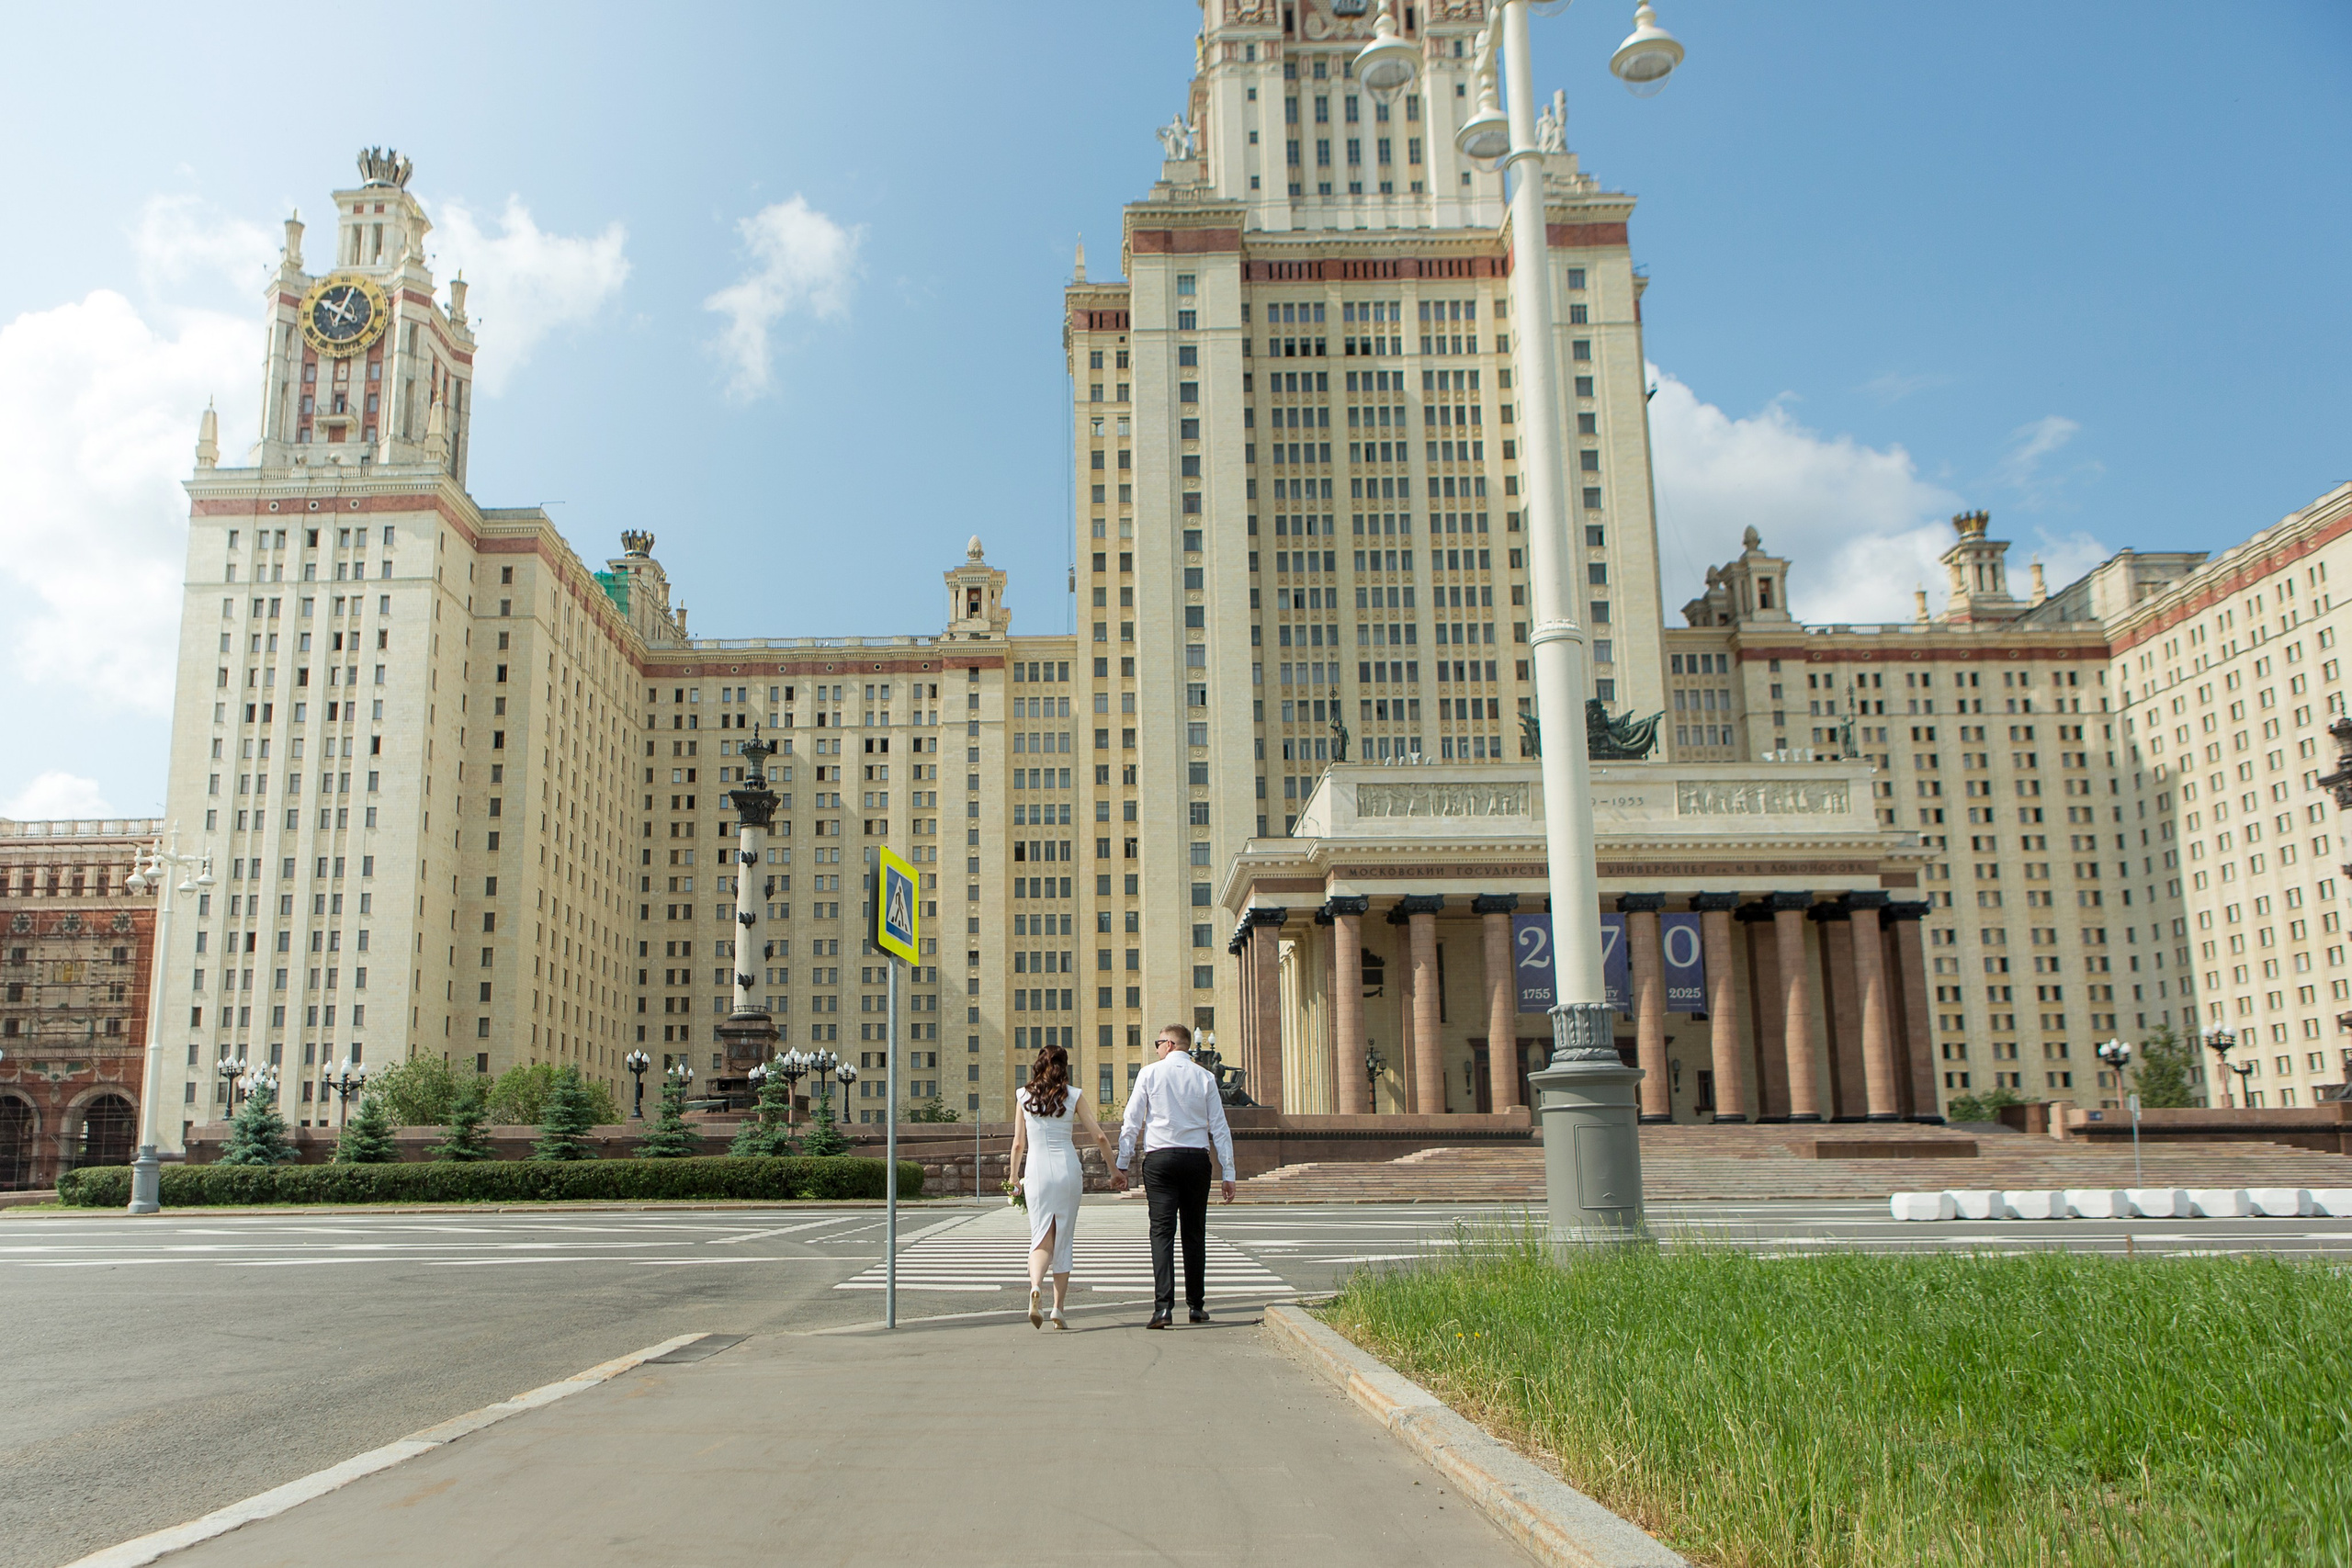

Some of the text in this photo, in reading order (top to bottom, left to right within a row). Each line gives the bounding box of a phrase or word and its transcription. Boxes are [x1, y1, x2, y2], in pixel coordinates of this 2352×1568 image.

[1590, 796, 1644, 807] 9-1953
[1456, 866, 1545, 875] ГОСУДАРСТВ
[1607, 864, 1707, 874] УНИВЕРСИТЕТ
[1770, 863, 1864, 873] ЛОМОНОСОВА
[1522, 987, 1551, 999] 1755
[1668, 987, 1701, 998] 2025
